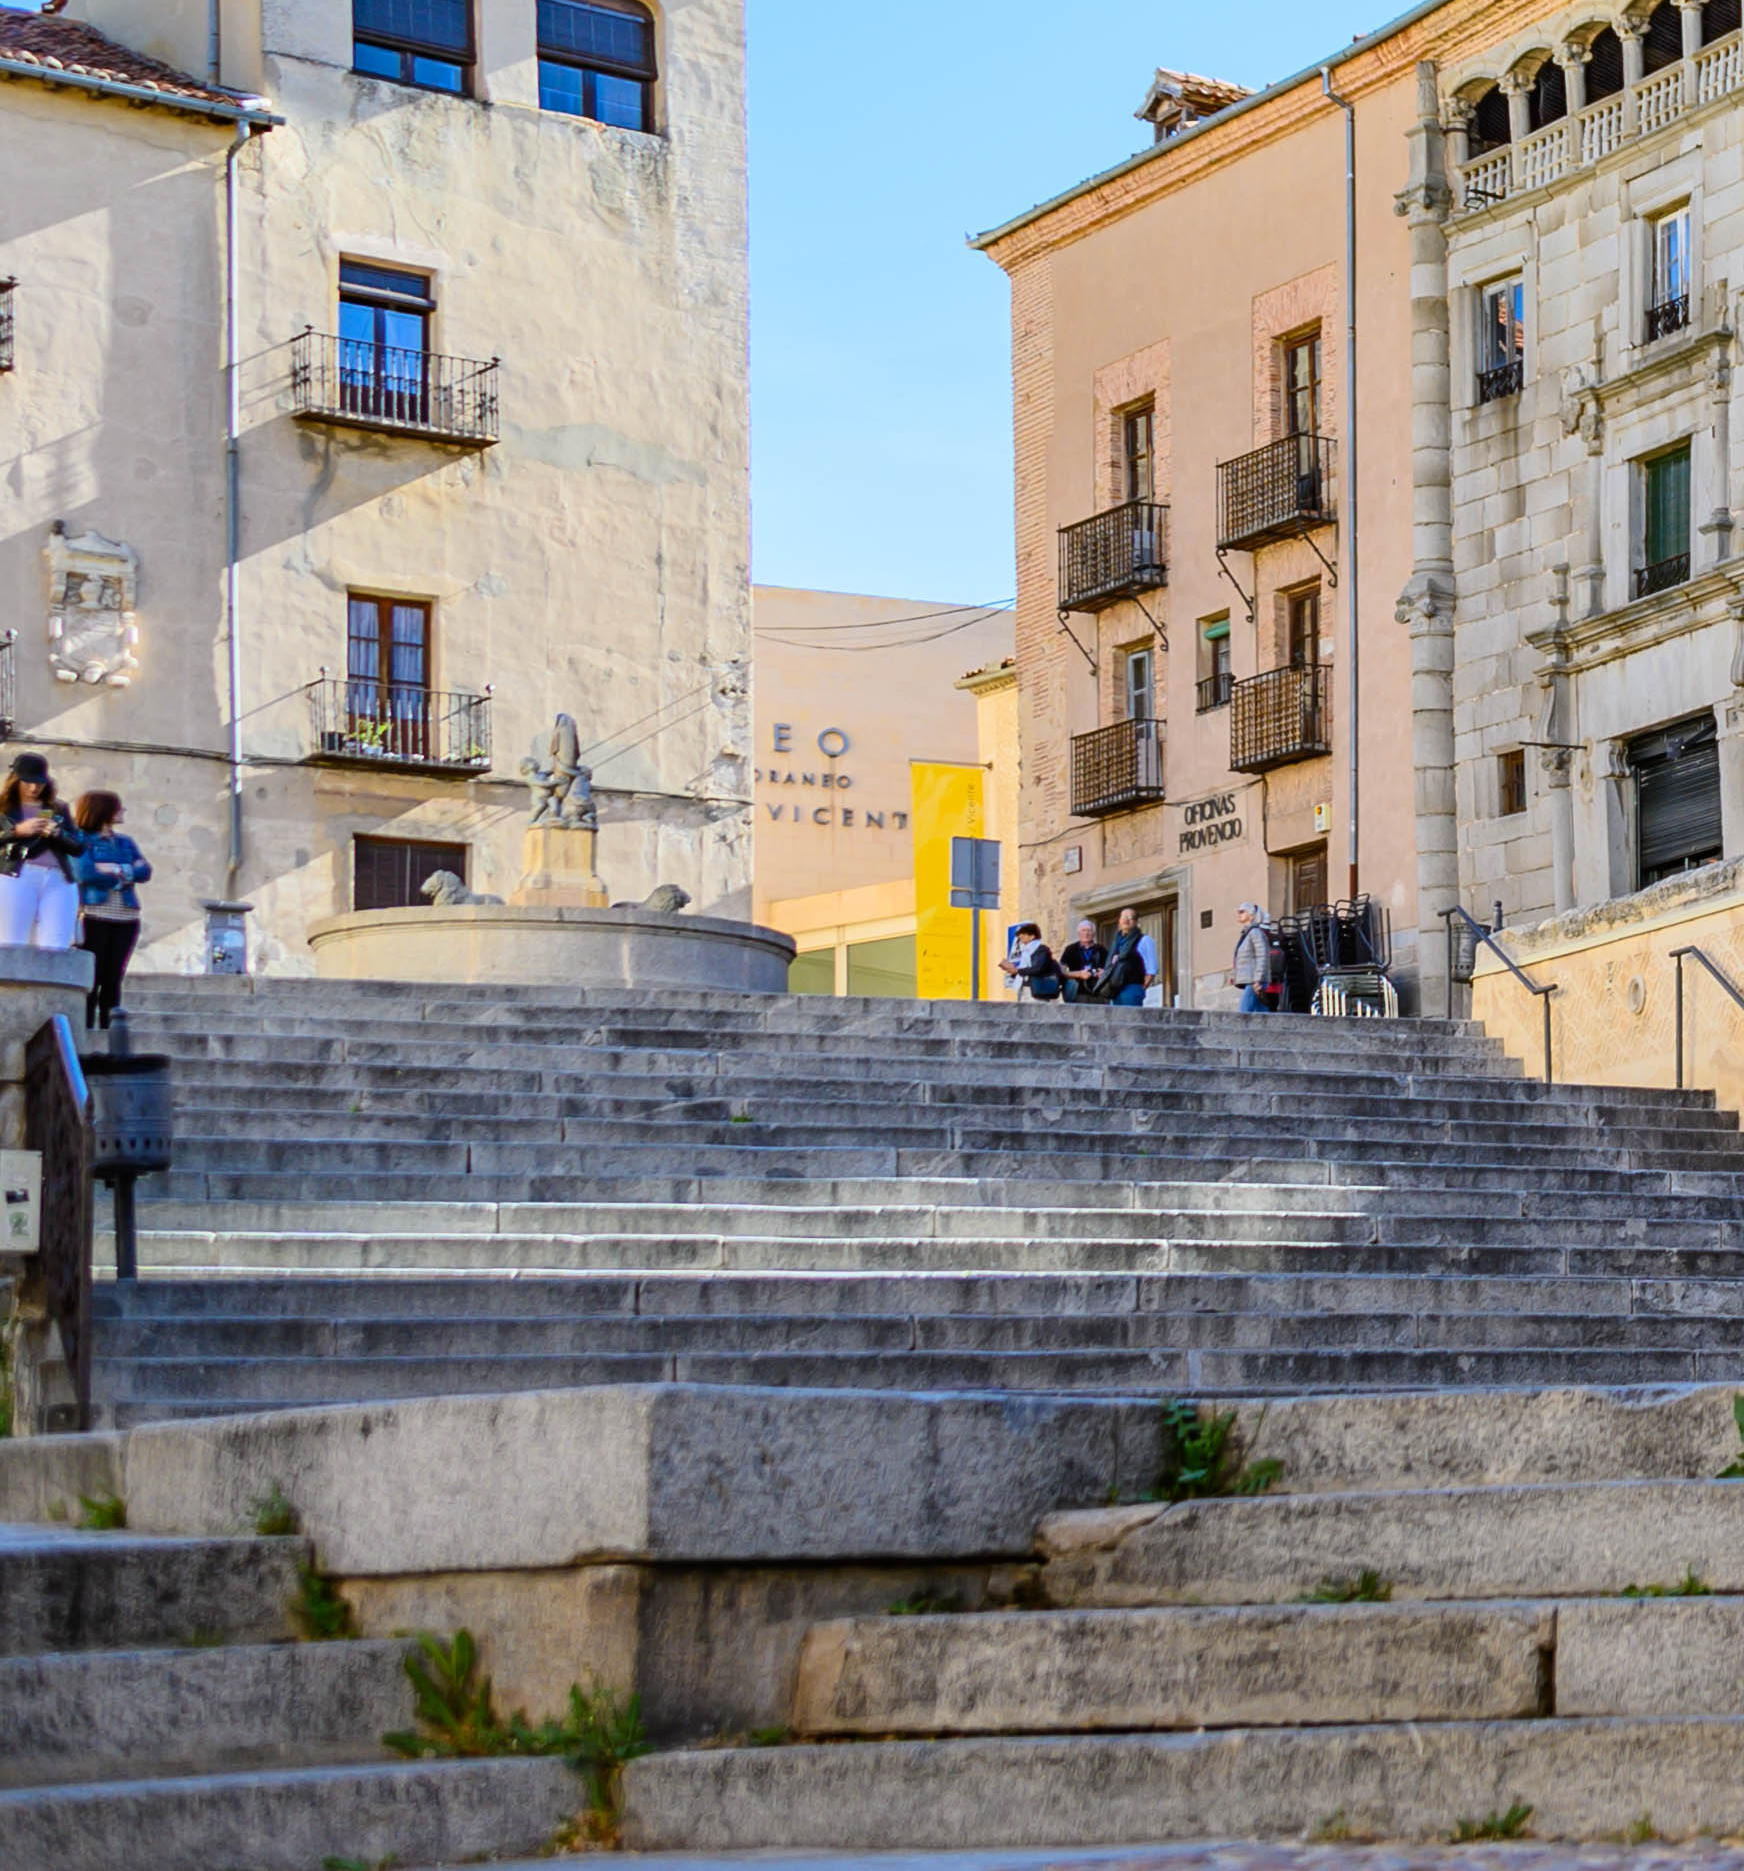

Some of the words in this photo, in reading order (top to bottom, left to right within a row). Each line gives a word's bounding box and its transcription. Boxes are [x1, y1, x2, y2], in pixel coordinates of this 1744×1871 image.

[773, 723, 850, 757] EO
[766, 803, 909, 830] VICENT
[1184, 793, 1237, 826] OFICINAS
[1179, 817, 1242, 853] PROVENCIO
